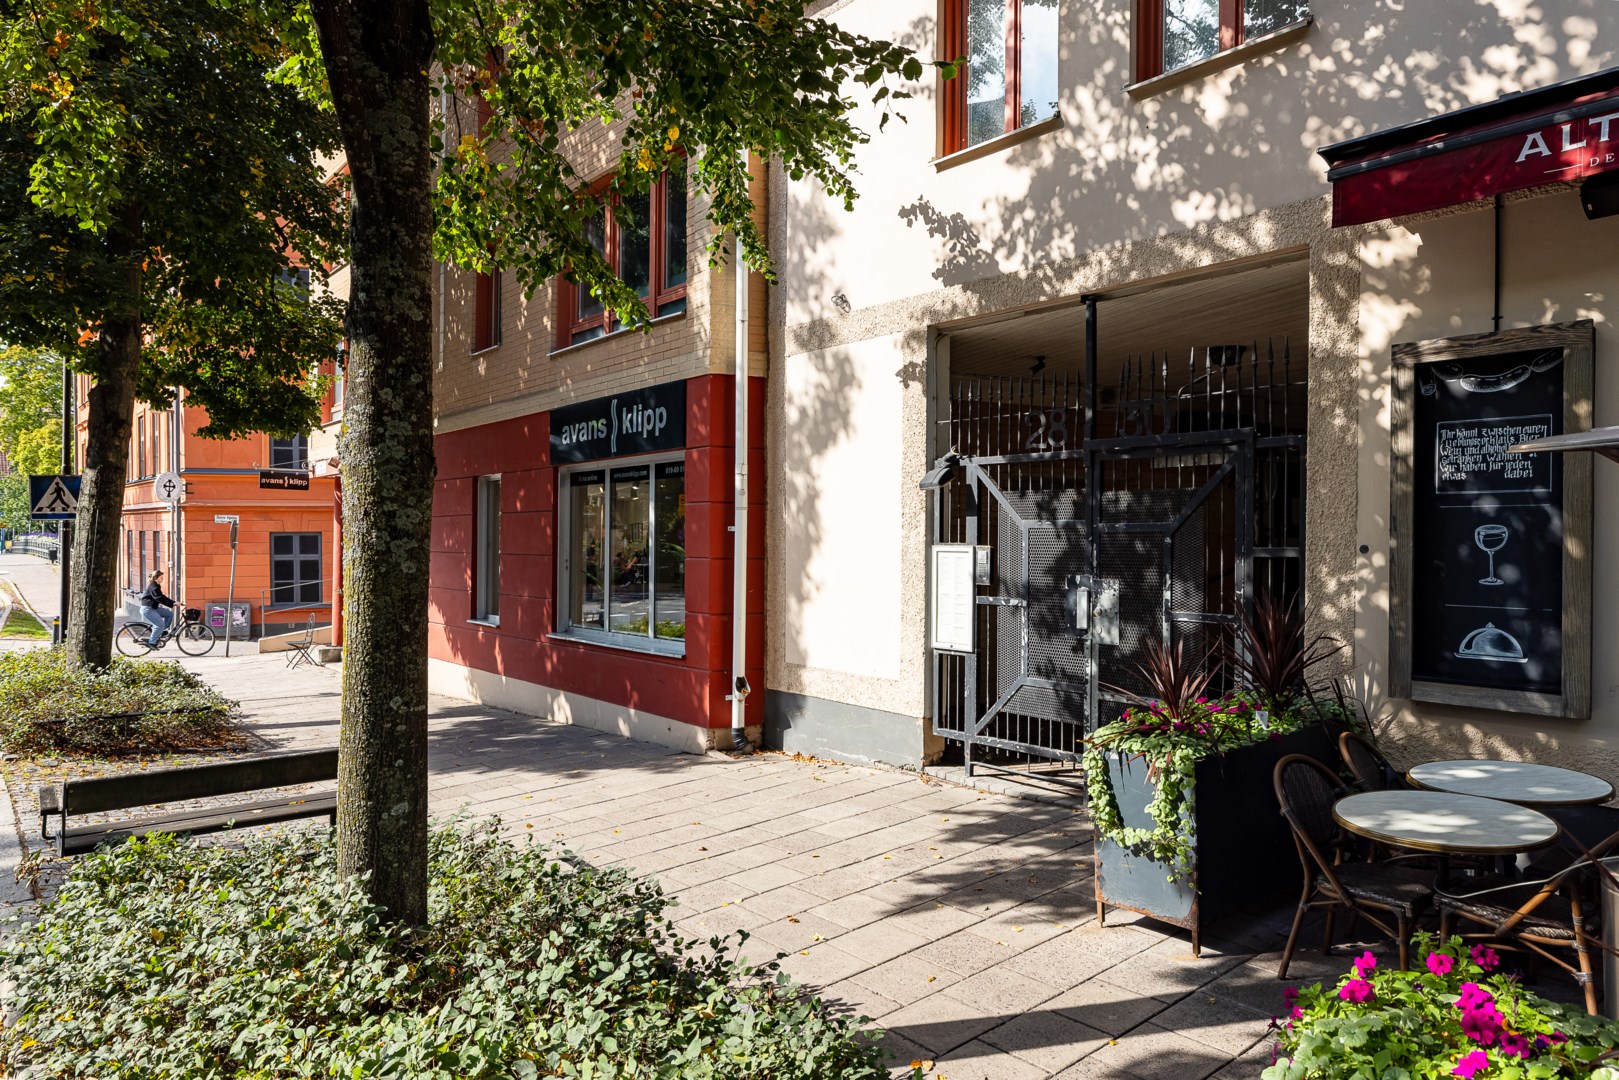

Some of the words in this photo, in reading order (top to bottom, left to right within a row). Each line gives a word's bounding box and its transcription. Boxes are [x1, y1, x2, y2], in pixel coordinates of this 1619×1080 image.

[561, 418, 607, 445] avans
[622, 403, 667, 439] klipp
[1024, 408, 1069, 449] 28
[1481, 426, 1521, 437] zwischen
[1522, 424, 1547, 438] euren
[1464, 446, 1480, 456] und
[1460, 462, 1486, 472] haben
[1442, 471, 1466, 480] etwas
[1504, 468, 1533, 479] dabei
[289, 478, 308, 486] klipp
